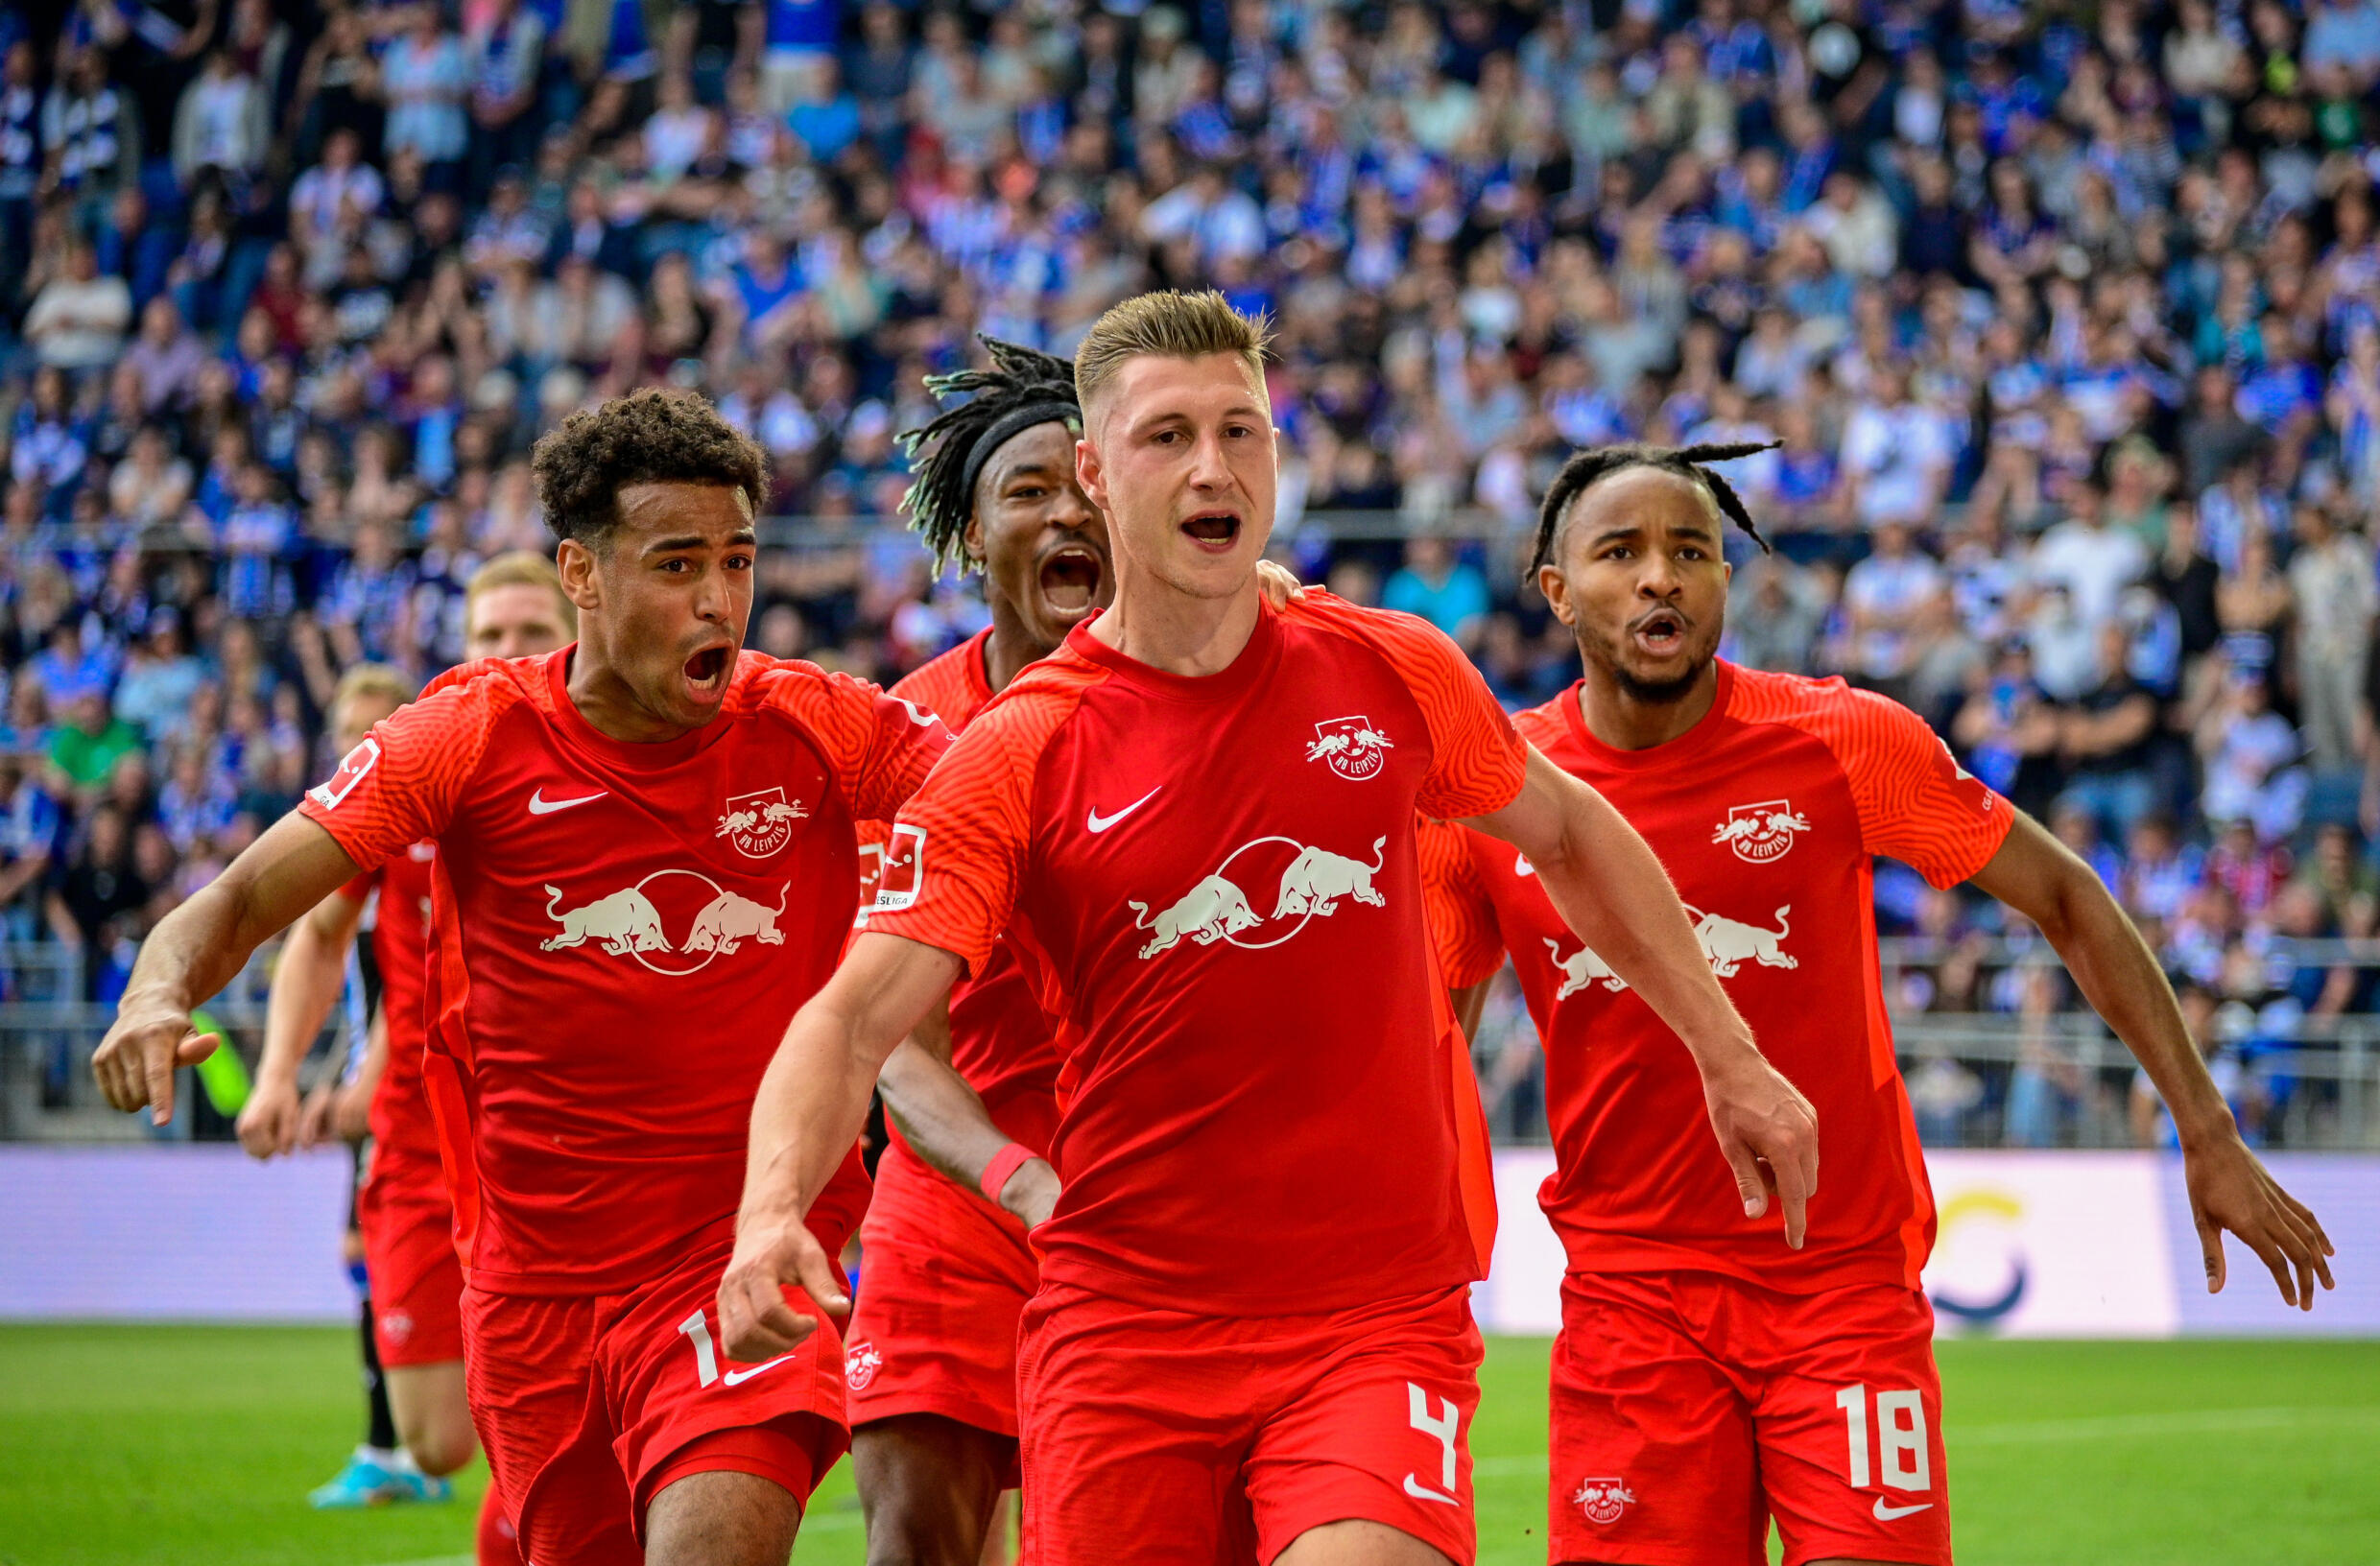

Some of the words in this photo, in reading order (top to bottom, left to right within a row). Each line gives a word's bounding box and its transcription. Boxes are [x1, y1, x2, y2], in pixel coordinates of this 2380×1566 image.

[1335, 756, 1348, 771] RB
[1350, 750, 1379, 773] LEIPZIG
[739, 834, 752, 849] RB
[753, 825, 786, 852] LEIPZIG
[1752, 834, 1788, 857] LEIPZIG
[1407, 1381, 1459, 1493] 4
[1836, 1383, 1931, 1492] 18
